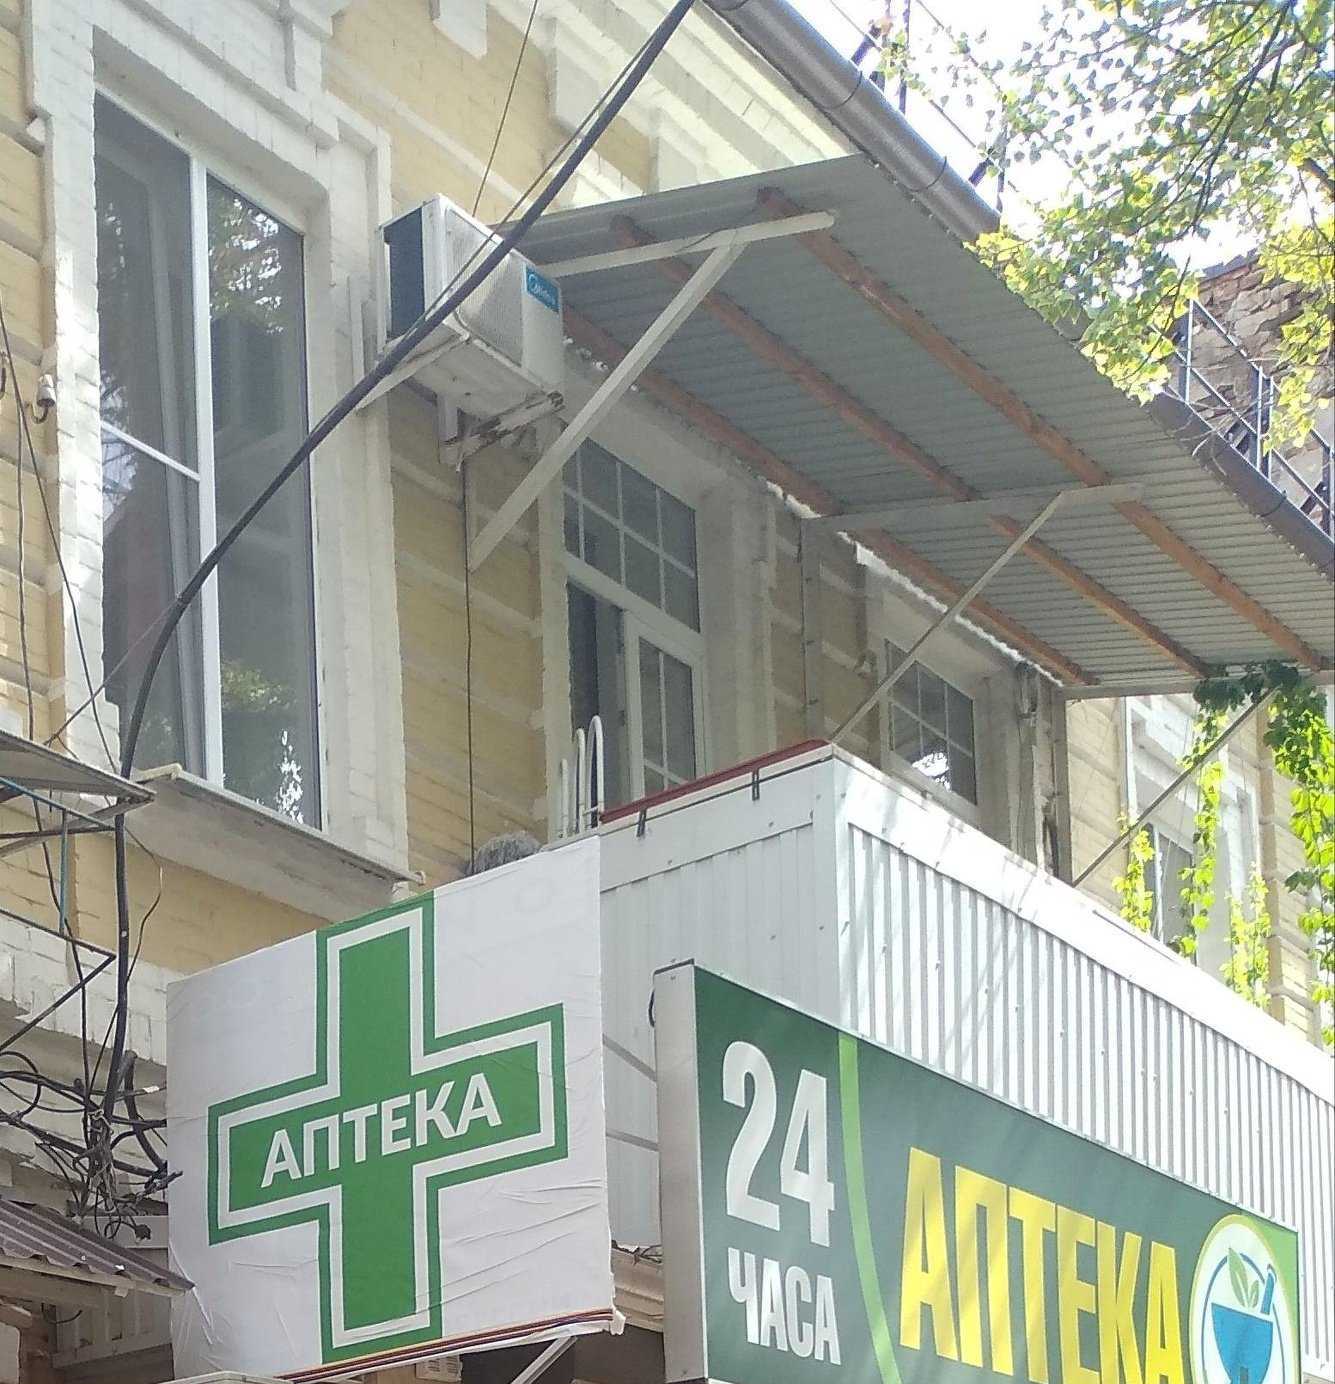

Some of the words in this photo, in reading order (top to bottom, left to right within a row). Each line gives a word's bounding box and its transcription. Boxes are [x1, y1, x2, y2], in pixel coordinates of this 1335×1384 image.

[261, 1073, 502, 1187] АПТЕКА
[722, 1040, 834, 1247] 24
[727, 1247, 841, 1366] ЧАСА
